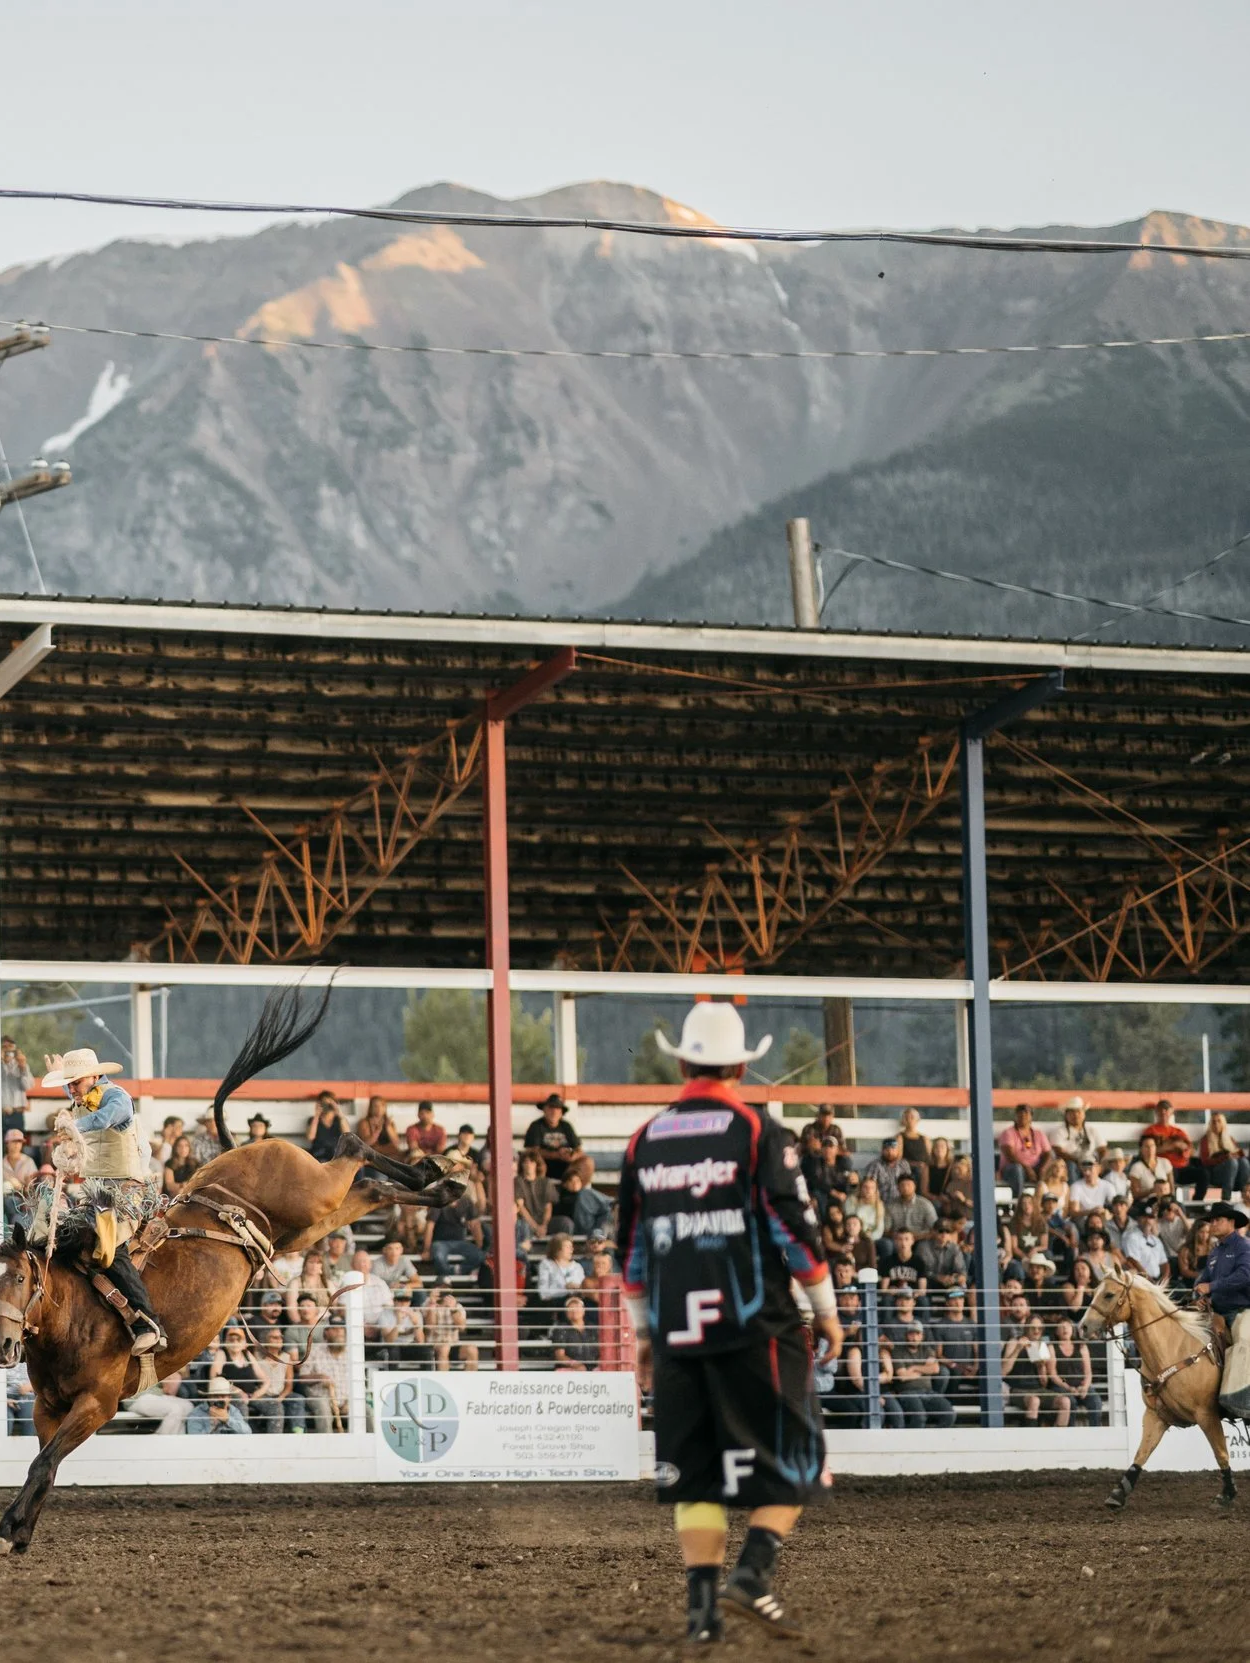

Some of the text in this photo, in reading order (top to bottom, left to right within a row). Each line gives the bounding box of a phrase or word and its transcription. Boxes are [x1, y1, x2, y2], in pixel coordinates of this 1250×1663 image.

[638, 1157, 738, 1197] Wrangler
[489, 1381, 610, 1398] Renaissance Design,
[466, 1401, 634, 1418] Fabrication & Powdercoating
[575, 1424, 600, 1432] Shop
[1225, 1435, 1250, 1447] AN
[570, 1443, 595, 1451] Shop
[1230, 1451, 1250, 1459] BIS
[400, 1470, 428, 1478] Your
[435, 1470, 464, 1478] One
[470, 1469, 501, 1478] Stop
[583, 1469, 619, 1478] Shop
